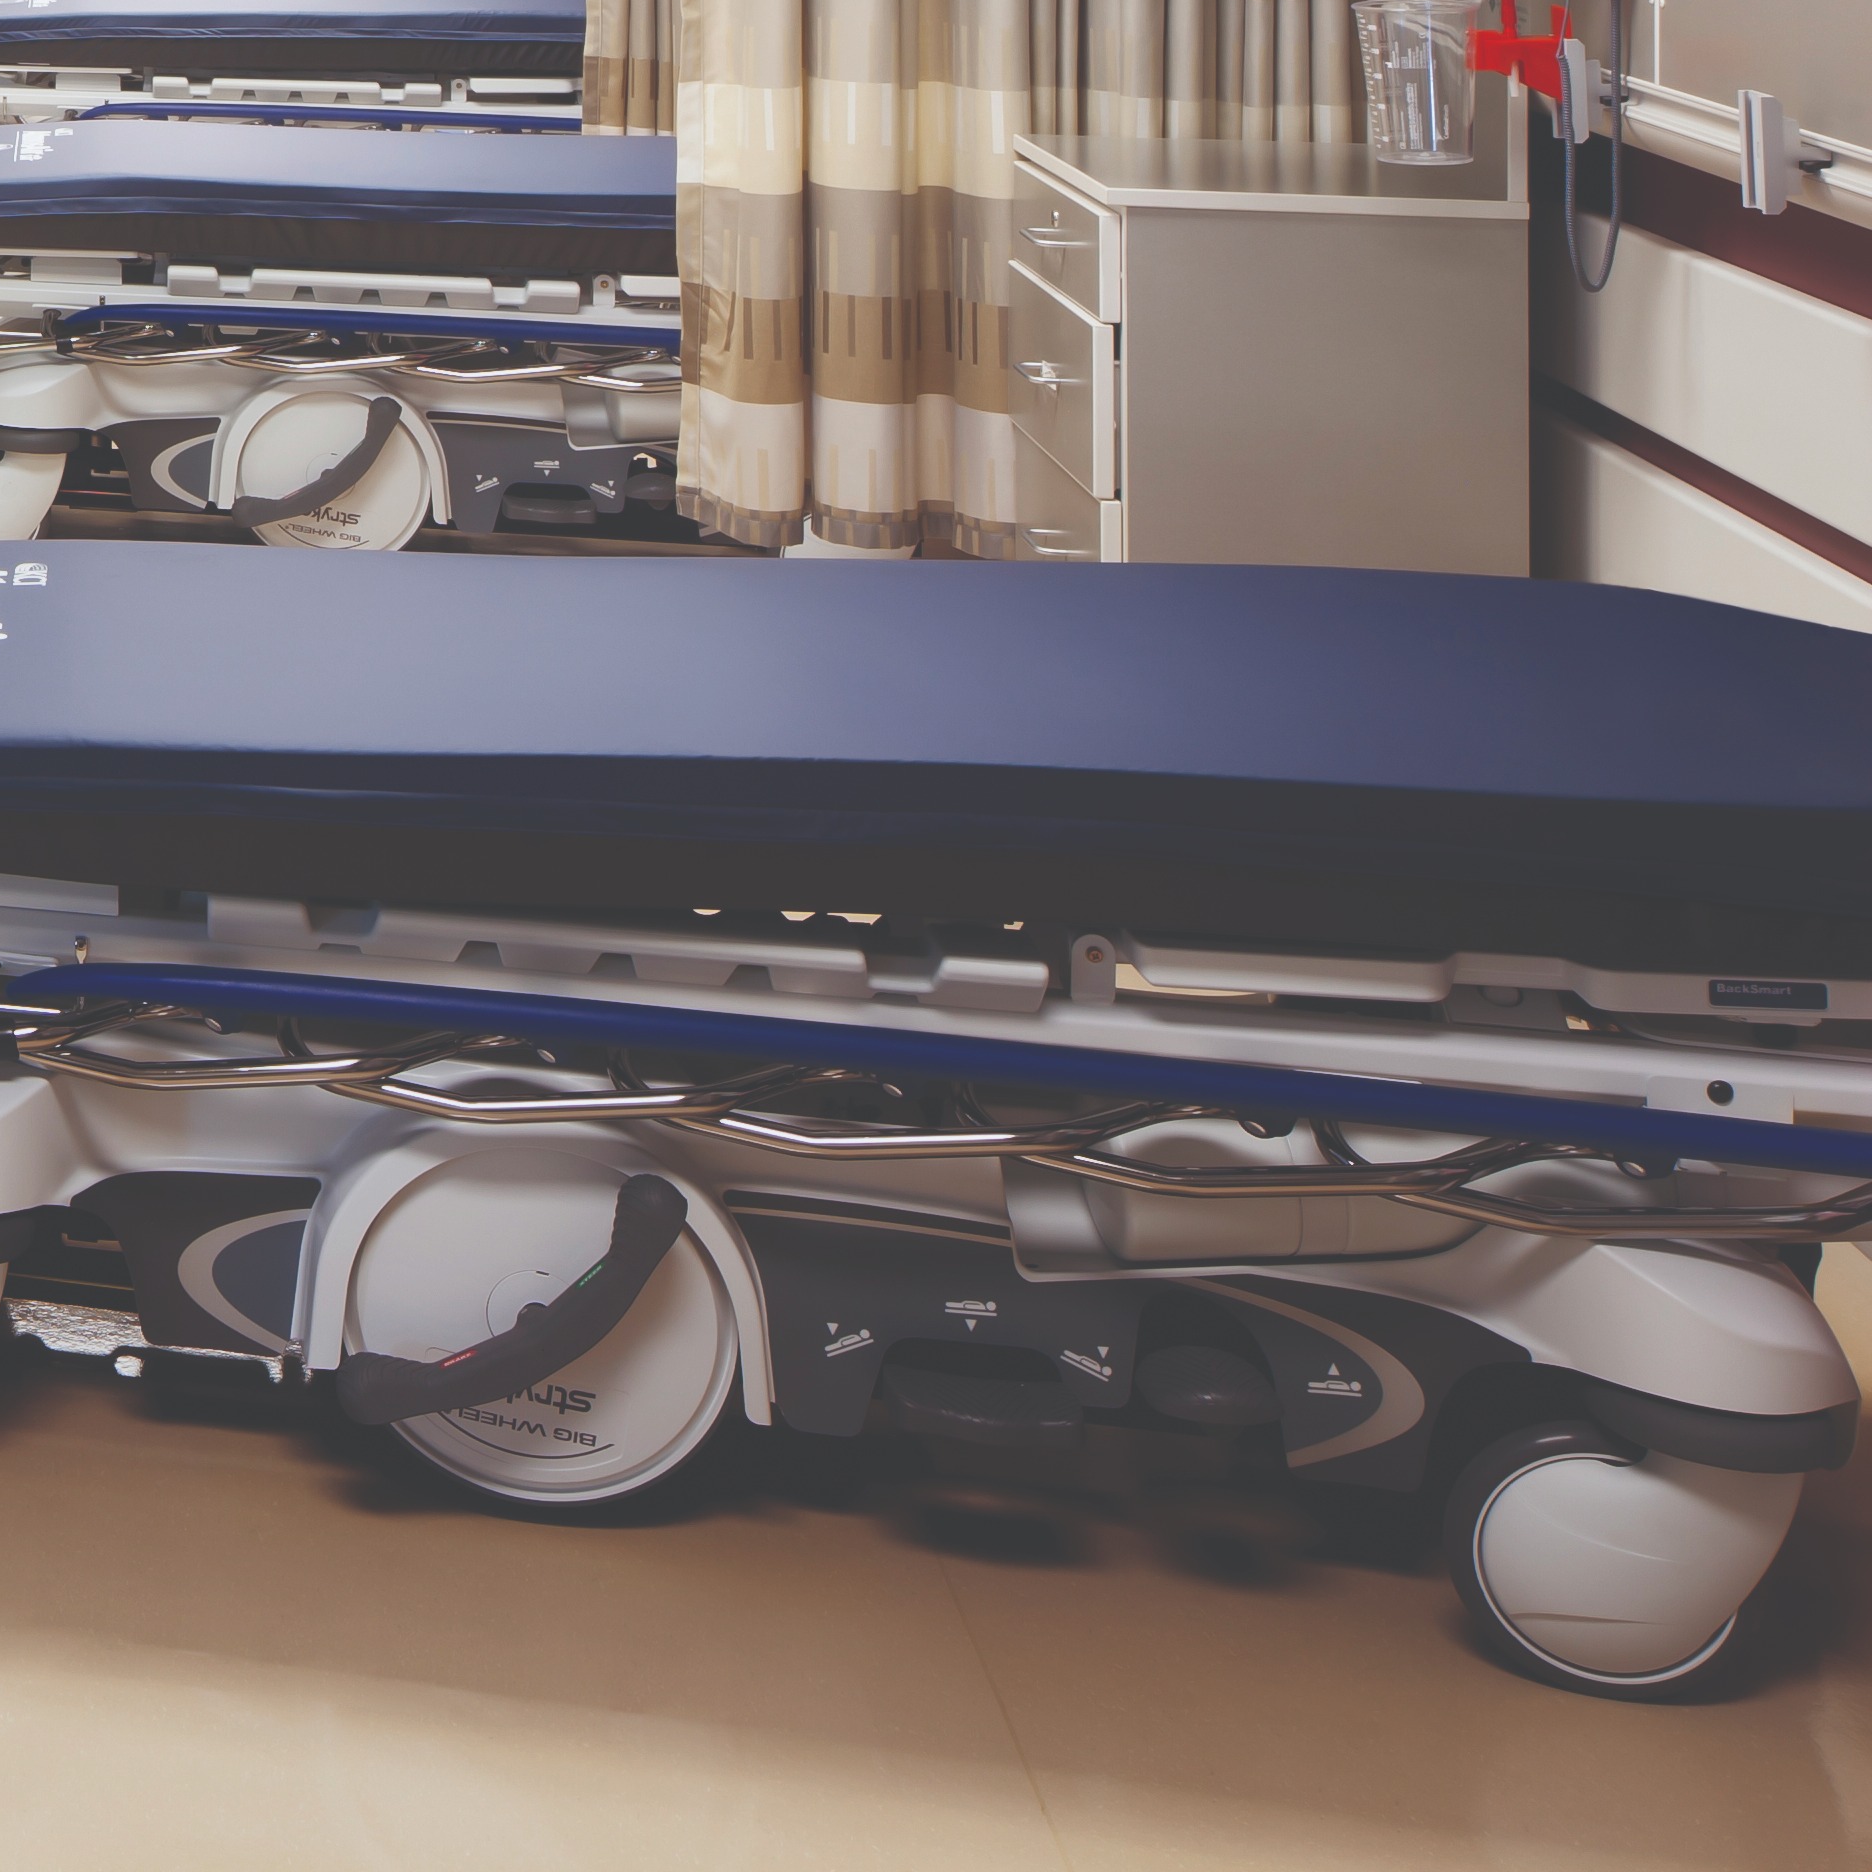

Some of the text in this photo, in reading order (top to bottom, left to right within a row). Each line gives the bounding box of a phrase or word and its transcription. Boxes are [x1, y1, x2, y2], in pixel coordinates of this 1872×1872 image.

[308, 507, 362, 527] stryk
[339, 532, 362, 543] BIG
[1716, 983, 1792, 995] BackSmart
[553, 1427, 597, 1447] BIG
